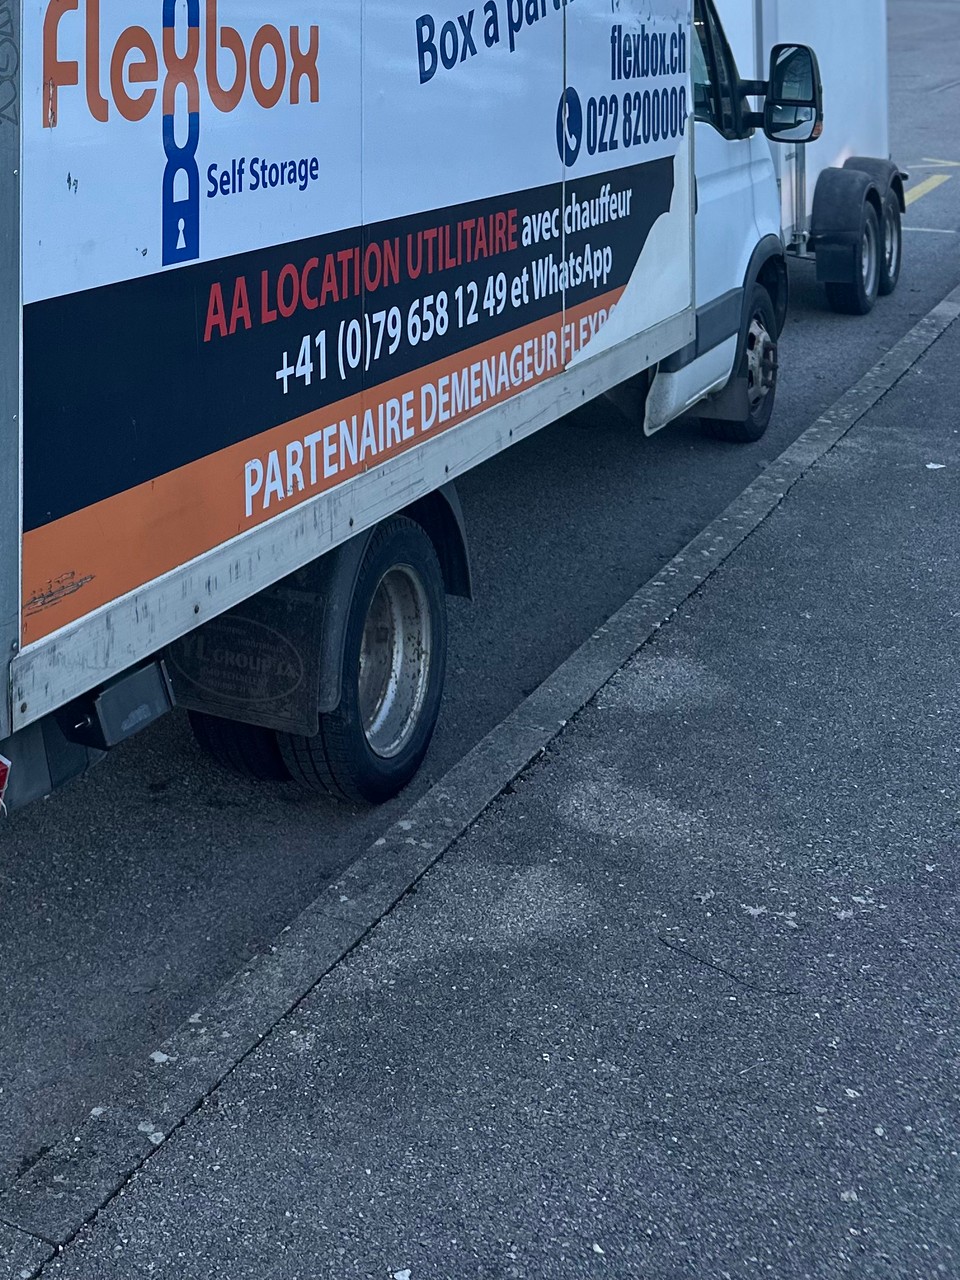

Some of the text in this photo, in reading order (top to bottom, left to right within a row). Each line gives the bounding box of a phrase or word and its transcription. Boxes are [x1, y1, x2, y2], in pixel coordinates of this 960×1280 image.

[416, 9, 477, 84] Box
[611, 24, 687, 80] flexbox.ch
[586, 86, 688, 156] 022 8200000
[207, 156, 320, 198] Self Storage
[203, 182, 633, 342] AA LOCATION UTILITAIRE avec chauffeur
[275, 243, 613, 394] +41 (0)79 658 12 49 et WhatsApp
[243, 389, 415, 517] PARTENAIRE
[420, 329, 558, 427] DEMENAGEUR
